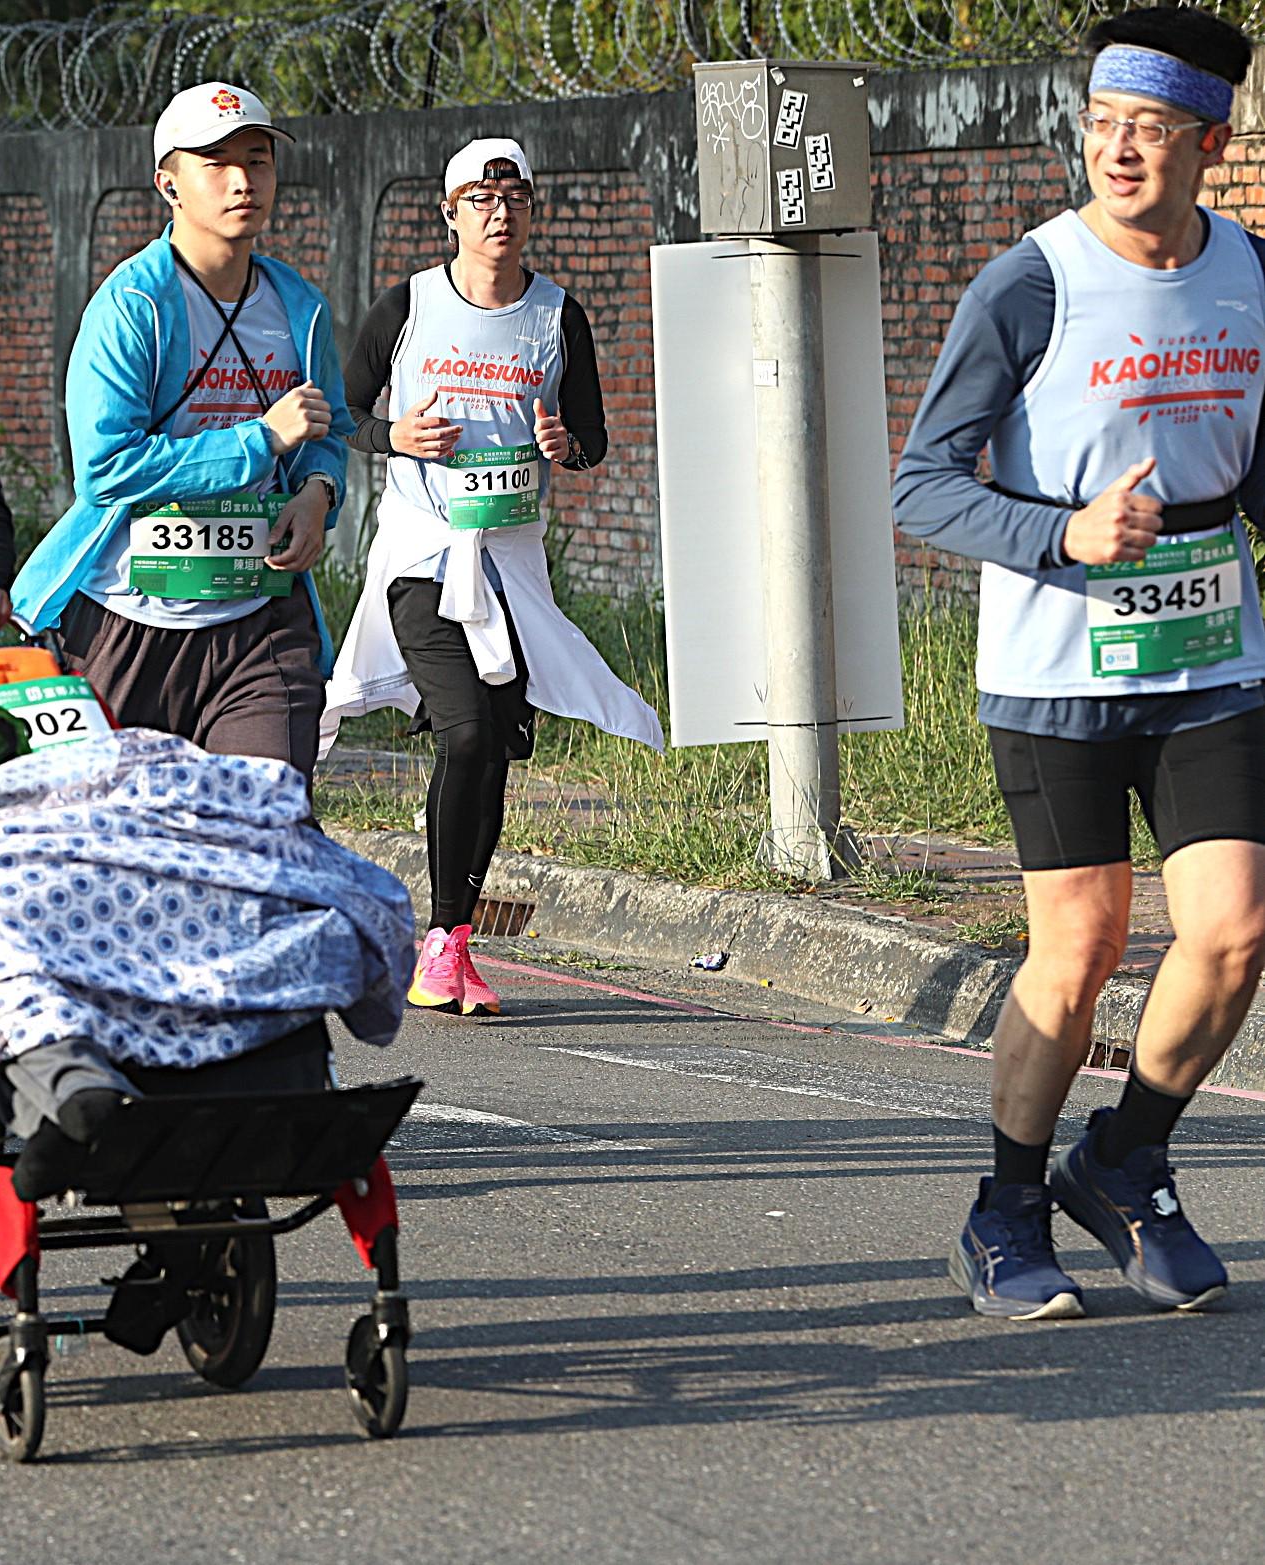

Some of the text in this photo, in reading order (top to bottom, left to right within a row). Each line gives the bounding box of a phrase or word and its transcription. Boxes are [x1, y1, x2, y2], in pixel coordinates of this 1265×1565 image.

[1158, 335, 1208, 346] FUBON
[218, 356, 256, 364] FUBN
[468, 352, 503, 361] FUBON
[1090, 347, 1261, 387] KAOHSIUNG
[422, 358, 544, 387] KAOHSIUNG
[459, 397, 502, 407] MARATHON
[464, 467, 530, 492] 31100
[151, 524, 254, 550] 33185
[1112, 573, 1221, 616] 33451
